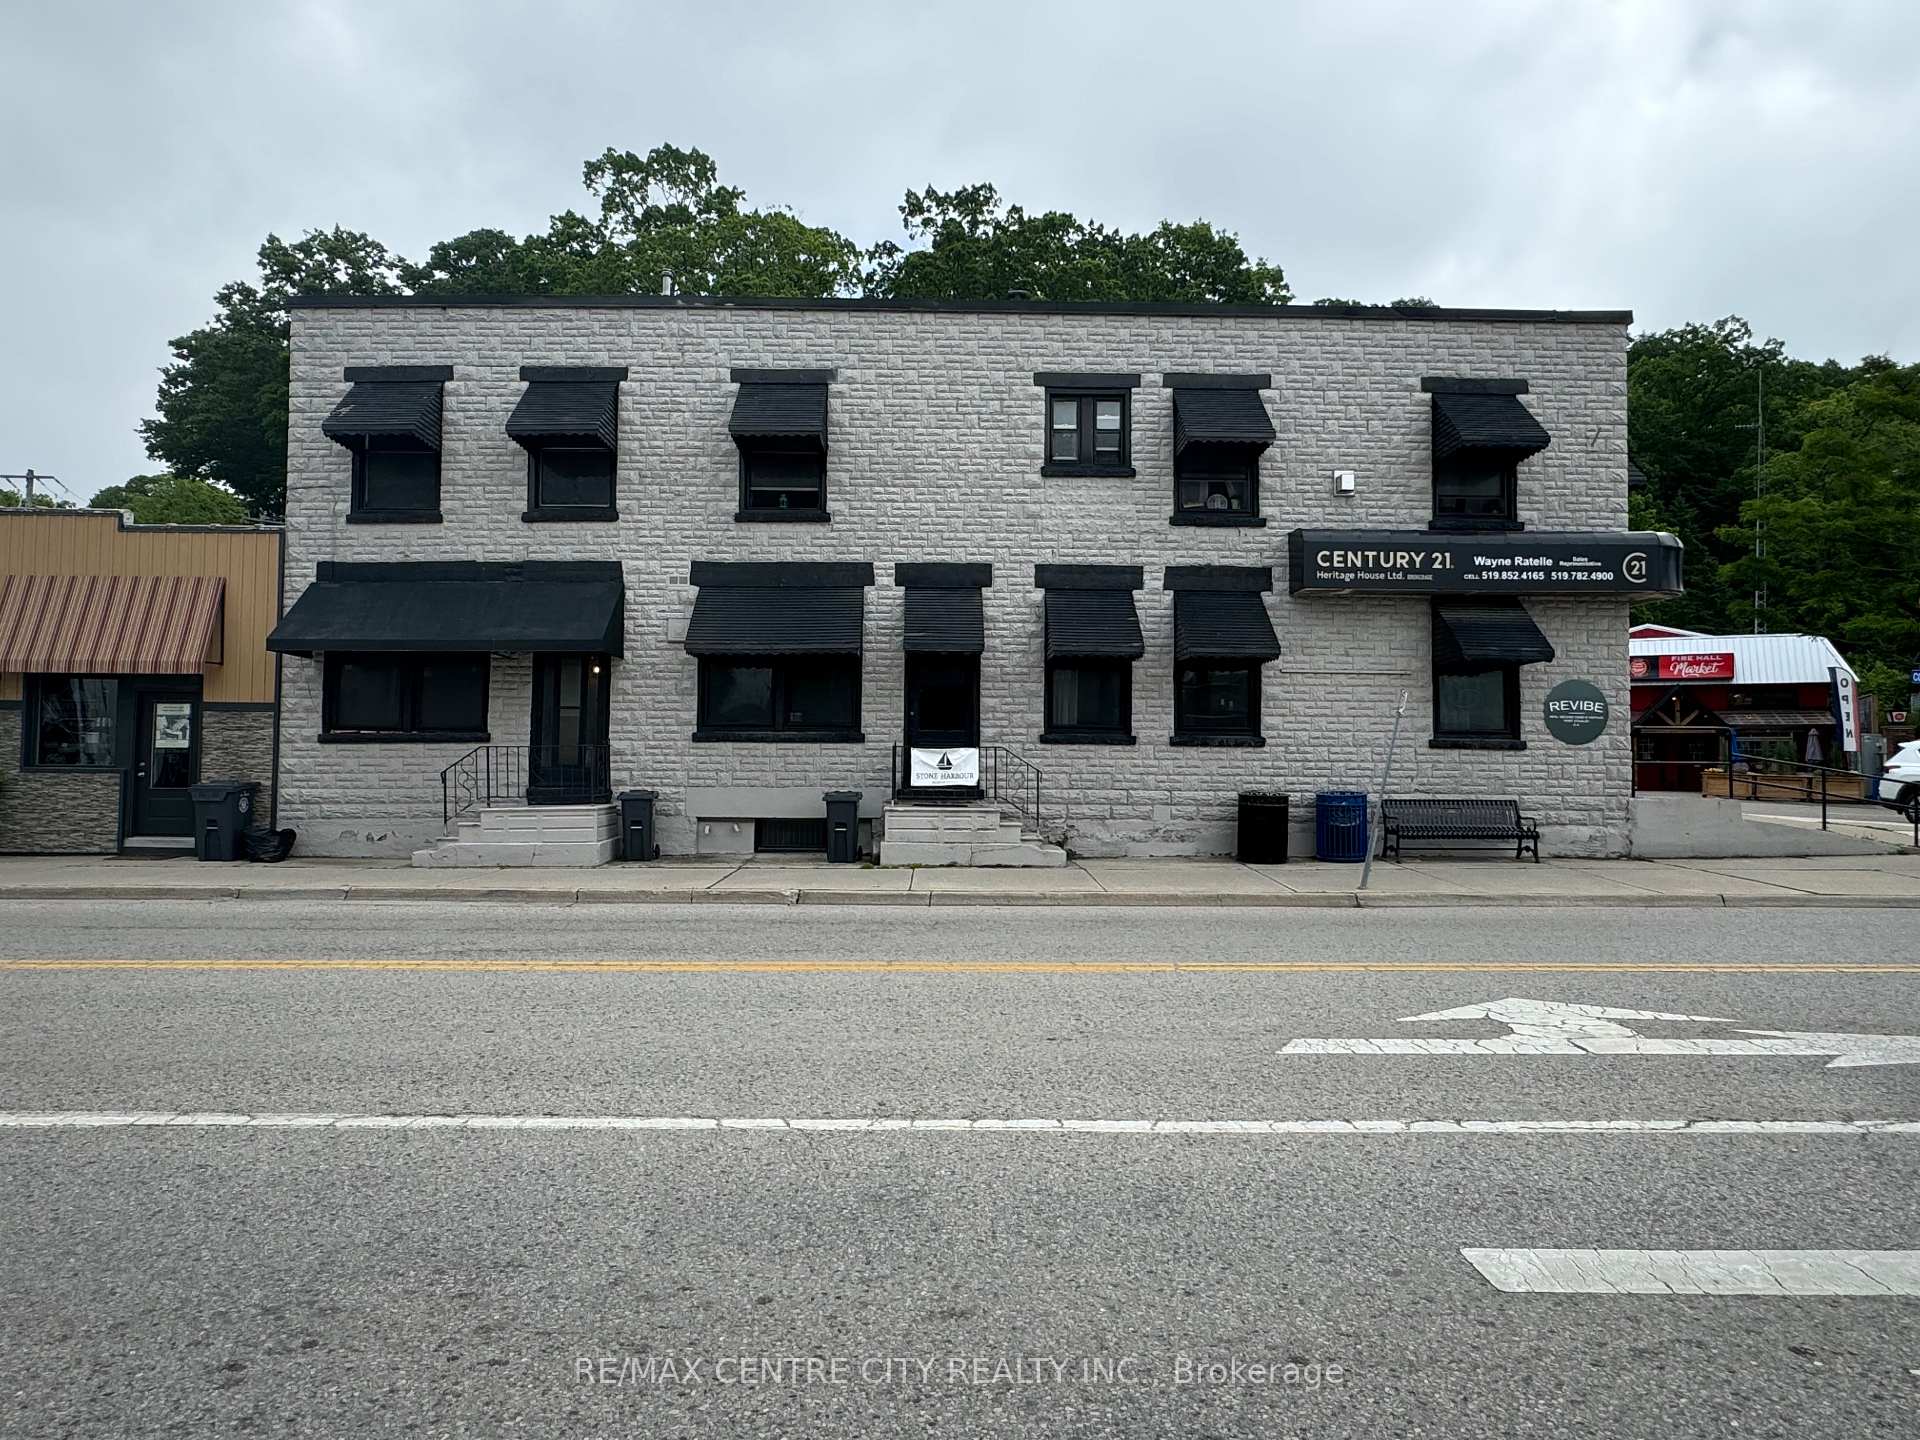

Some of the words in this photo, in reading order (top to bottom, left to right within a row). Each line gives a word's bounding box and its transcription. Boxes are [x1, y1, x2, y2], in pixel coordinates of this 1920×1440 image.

[1316, 550, 1426, 569] CENTURY
[1473, 555, 1512, 568] Wayne
[1514, 555, 1553, 567] Ratelle
[1630, 560, 1646, 575] 21
[1316, 570, 1355, 582] Heritage
[1357, 570, 1385, 580] House
[1387, 570, 1405, 580] Ltd.
[1481, 571, 1545, 581] 519.852.4165
[1551, 571, 1614, 581] 519.782.4900
[1669, 661, 1725, 677] Market
[1549, 700, 1604, 713] REVIBE
